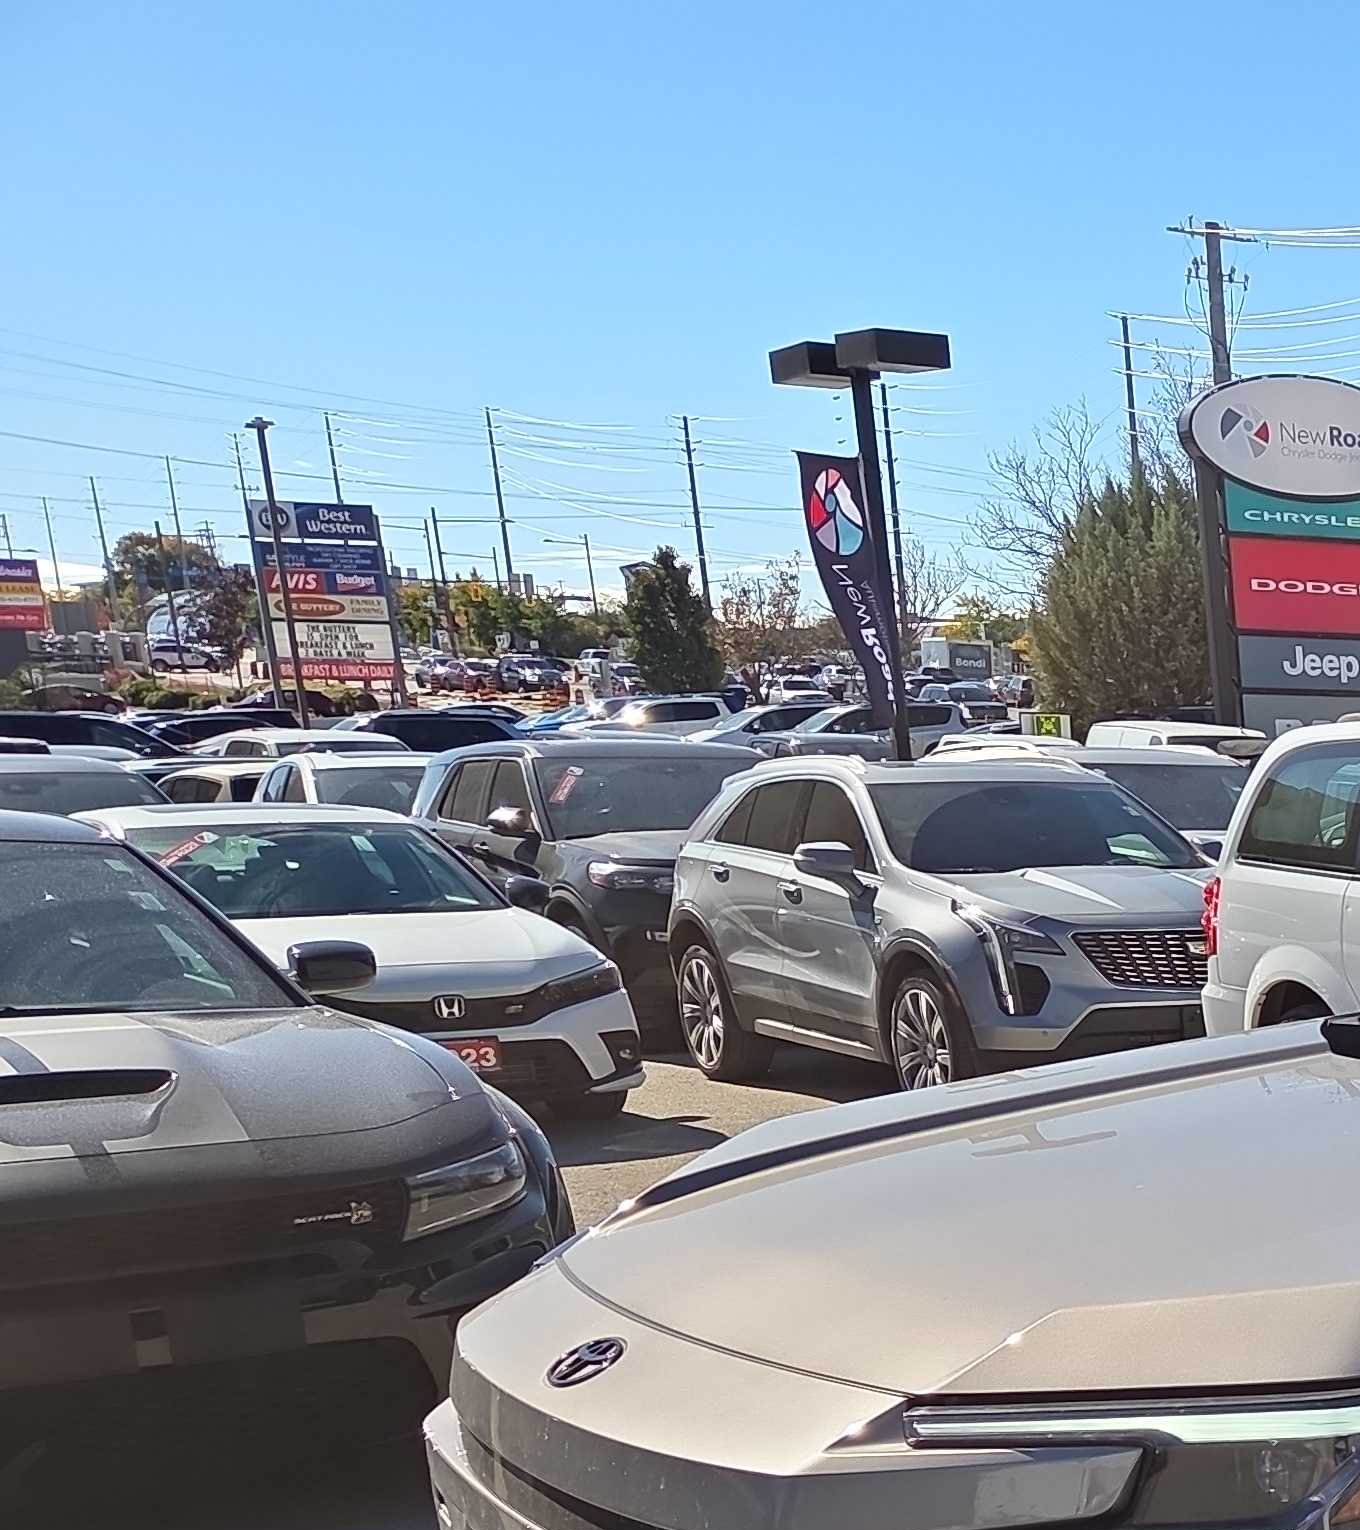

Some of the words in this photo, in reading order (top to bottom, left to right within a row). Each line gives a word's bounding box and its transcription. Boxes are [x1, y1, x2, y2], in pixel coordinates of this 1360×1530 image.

[318, 508, 351, 522] Best
[306, 519, 366, 535] Western
[271, 573, 317, 590] AVIS
[335, 573, 375, 588] Budget
[306, 624, 321, 632] THE
[323, 625, 357, 633] BUTTERY
[350, 641, 375, 650] LUNCH
[955, 657, 986, 668] Bondi
[1282, 645, 1360, 684] Jeep
[339, 664, 369, 678] LUNCH
[370, 665, 394, 678] DAILY
